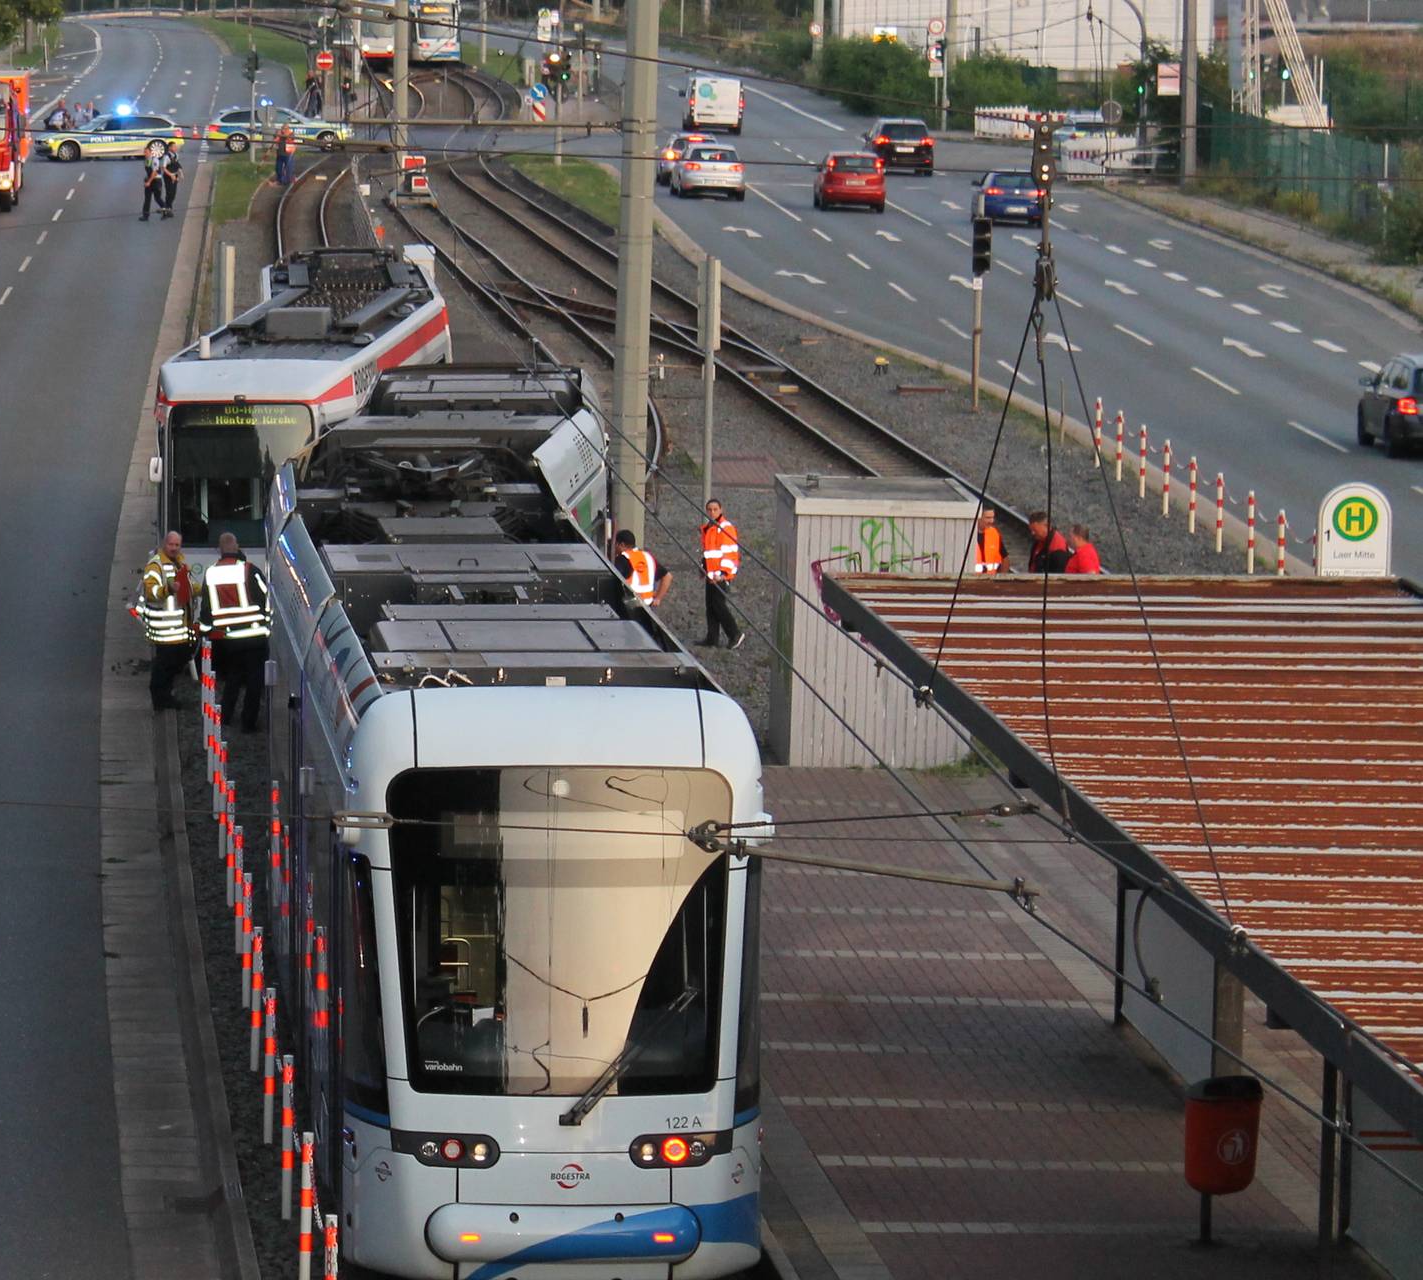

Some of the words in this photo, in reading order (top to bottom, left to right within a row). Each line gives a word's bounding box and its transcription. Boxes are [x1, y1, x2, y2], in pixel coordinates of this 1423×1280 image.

[1324, 529, 1330, 541] 1
[1333, 551, 1352, 559] Laer
[1354, 551, 1376, 559] Mitte
[424, 1063, 463, 1072] variobahn
[665, 1116, 689, 1129] 122
[691, 1116, 702, 1128] A
[550, 1172, 591, 1181] BOGESTRA
